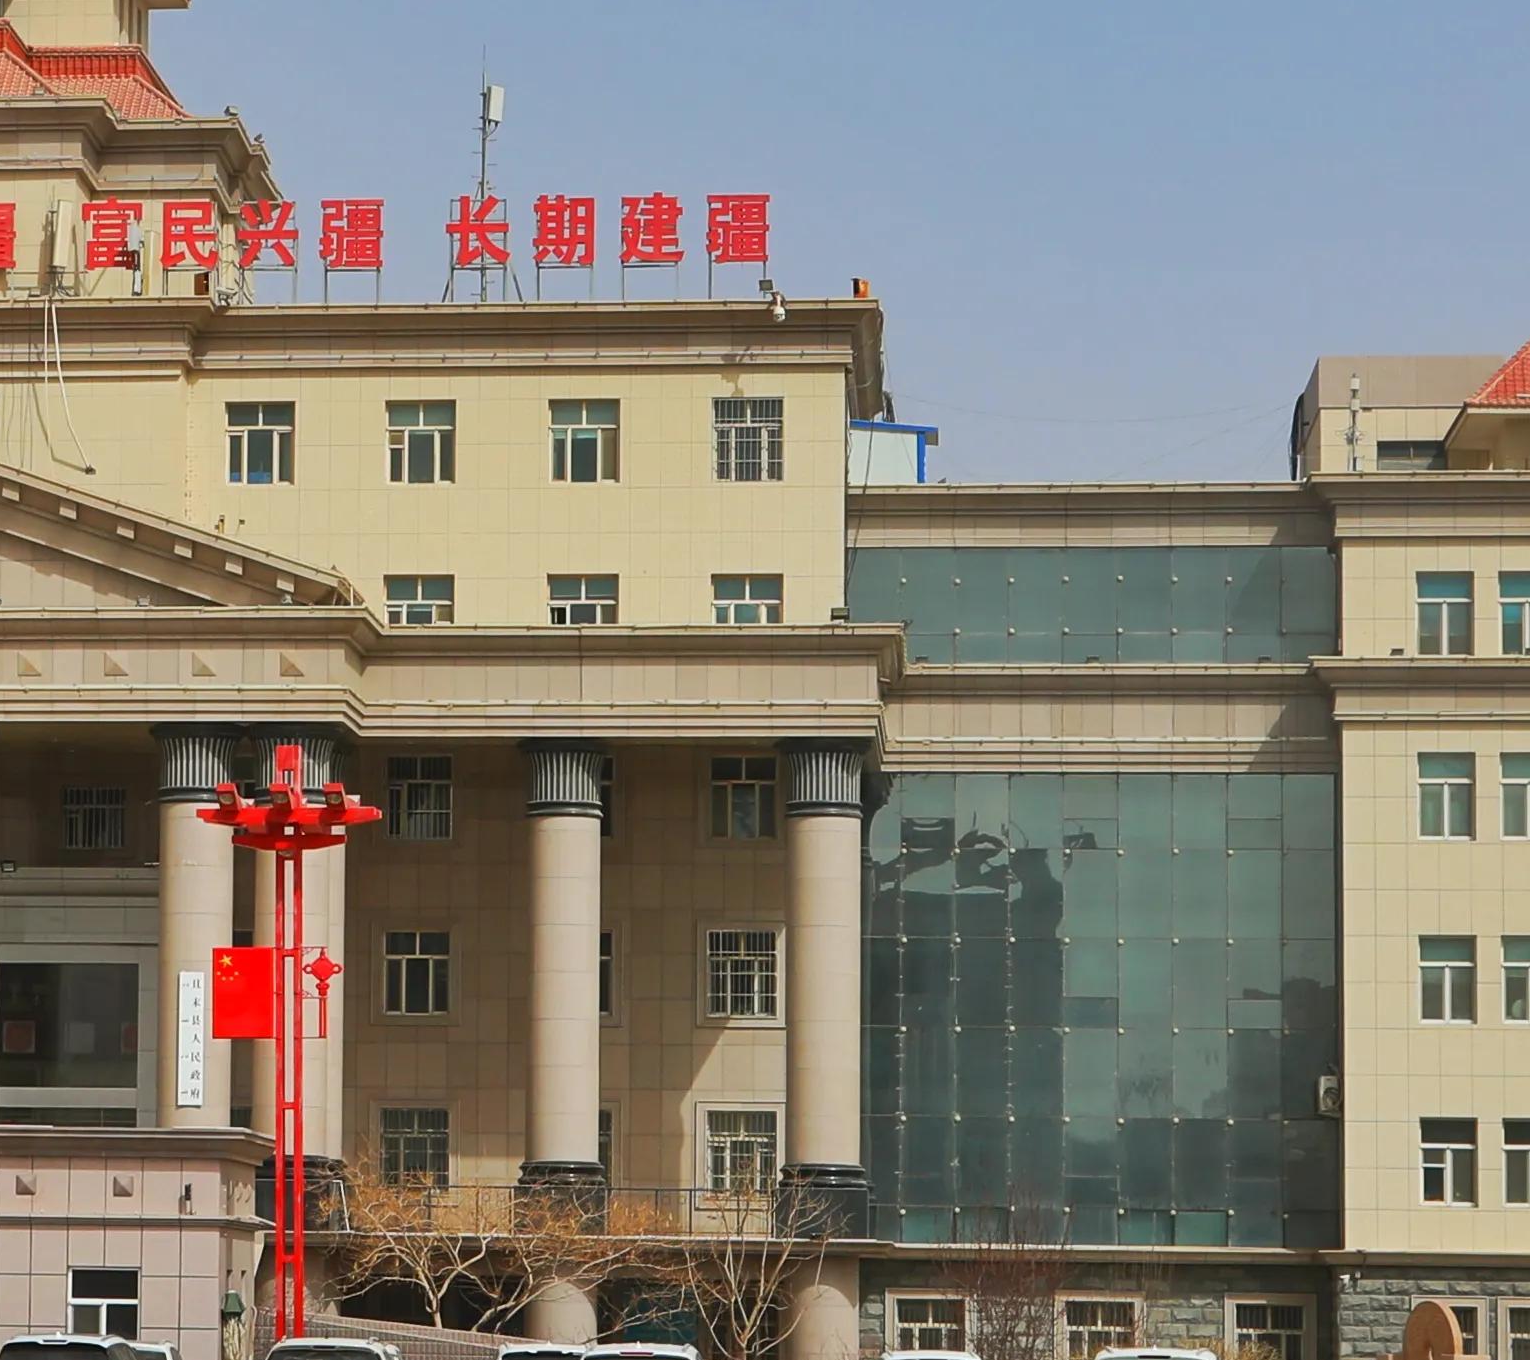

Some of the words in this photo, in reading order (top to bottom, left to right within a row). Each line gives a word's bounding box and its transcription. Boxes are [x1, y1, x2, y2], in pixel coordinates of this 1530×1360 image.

[80, 194, 383, 271] 富民兴疆
[446, 194, 771, 265] 长期建疆
